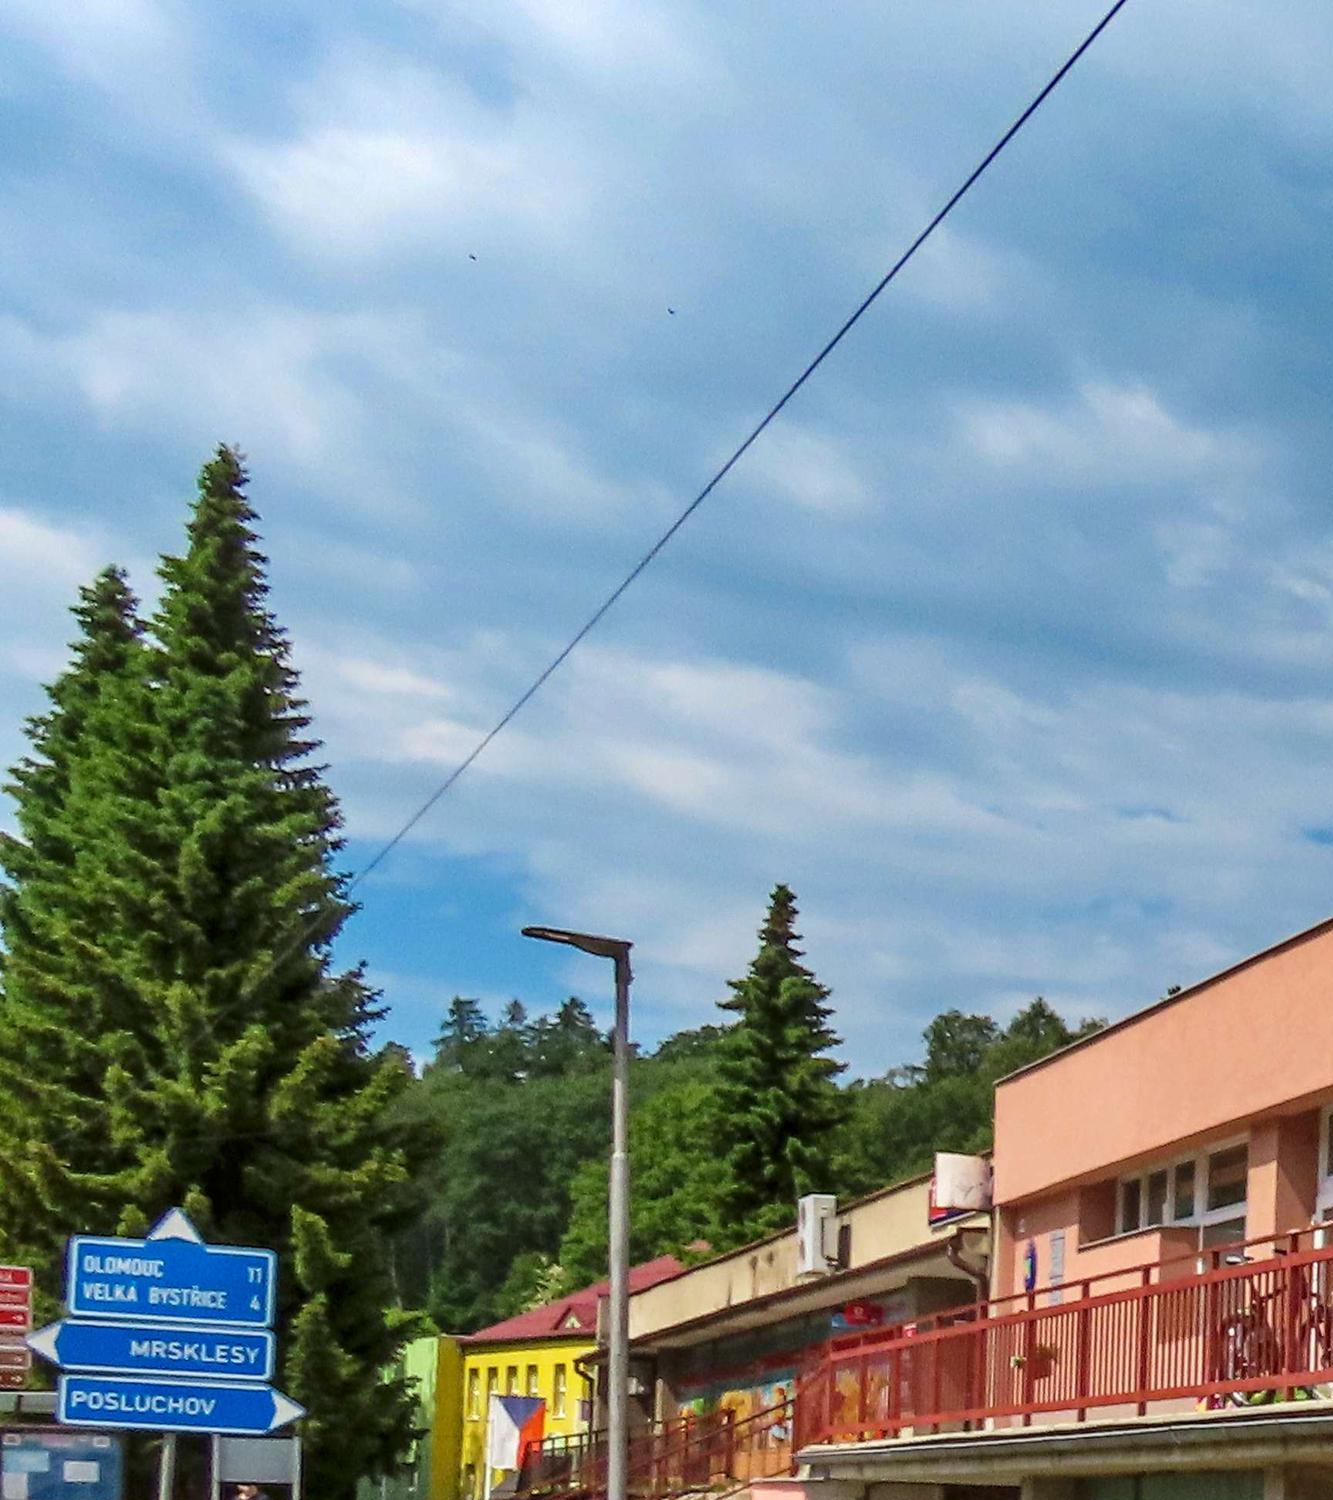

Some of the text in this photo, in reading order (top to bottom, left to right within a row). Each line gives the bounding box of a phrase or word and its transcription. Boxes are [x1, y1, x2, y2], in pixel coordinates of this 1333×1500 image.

[82, 1255, 264, 1284] OLOMOUC 11
[82, 1282, 262, 1311] VELKÁ BYSTŘICE 4
[129, 1340, 260, 1364] MRSKLESY
[71, 1390, 217, 1416] POSLUCHOV
